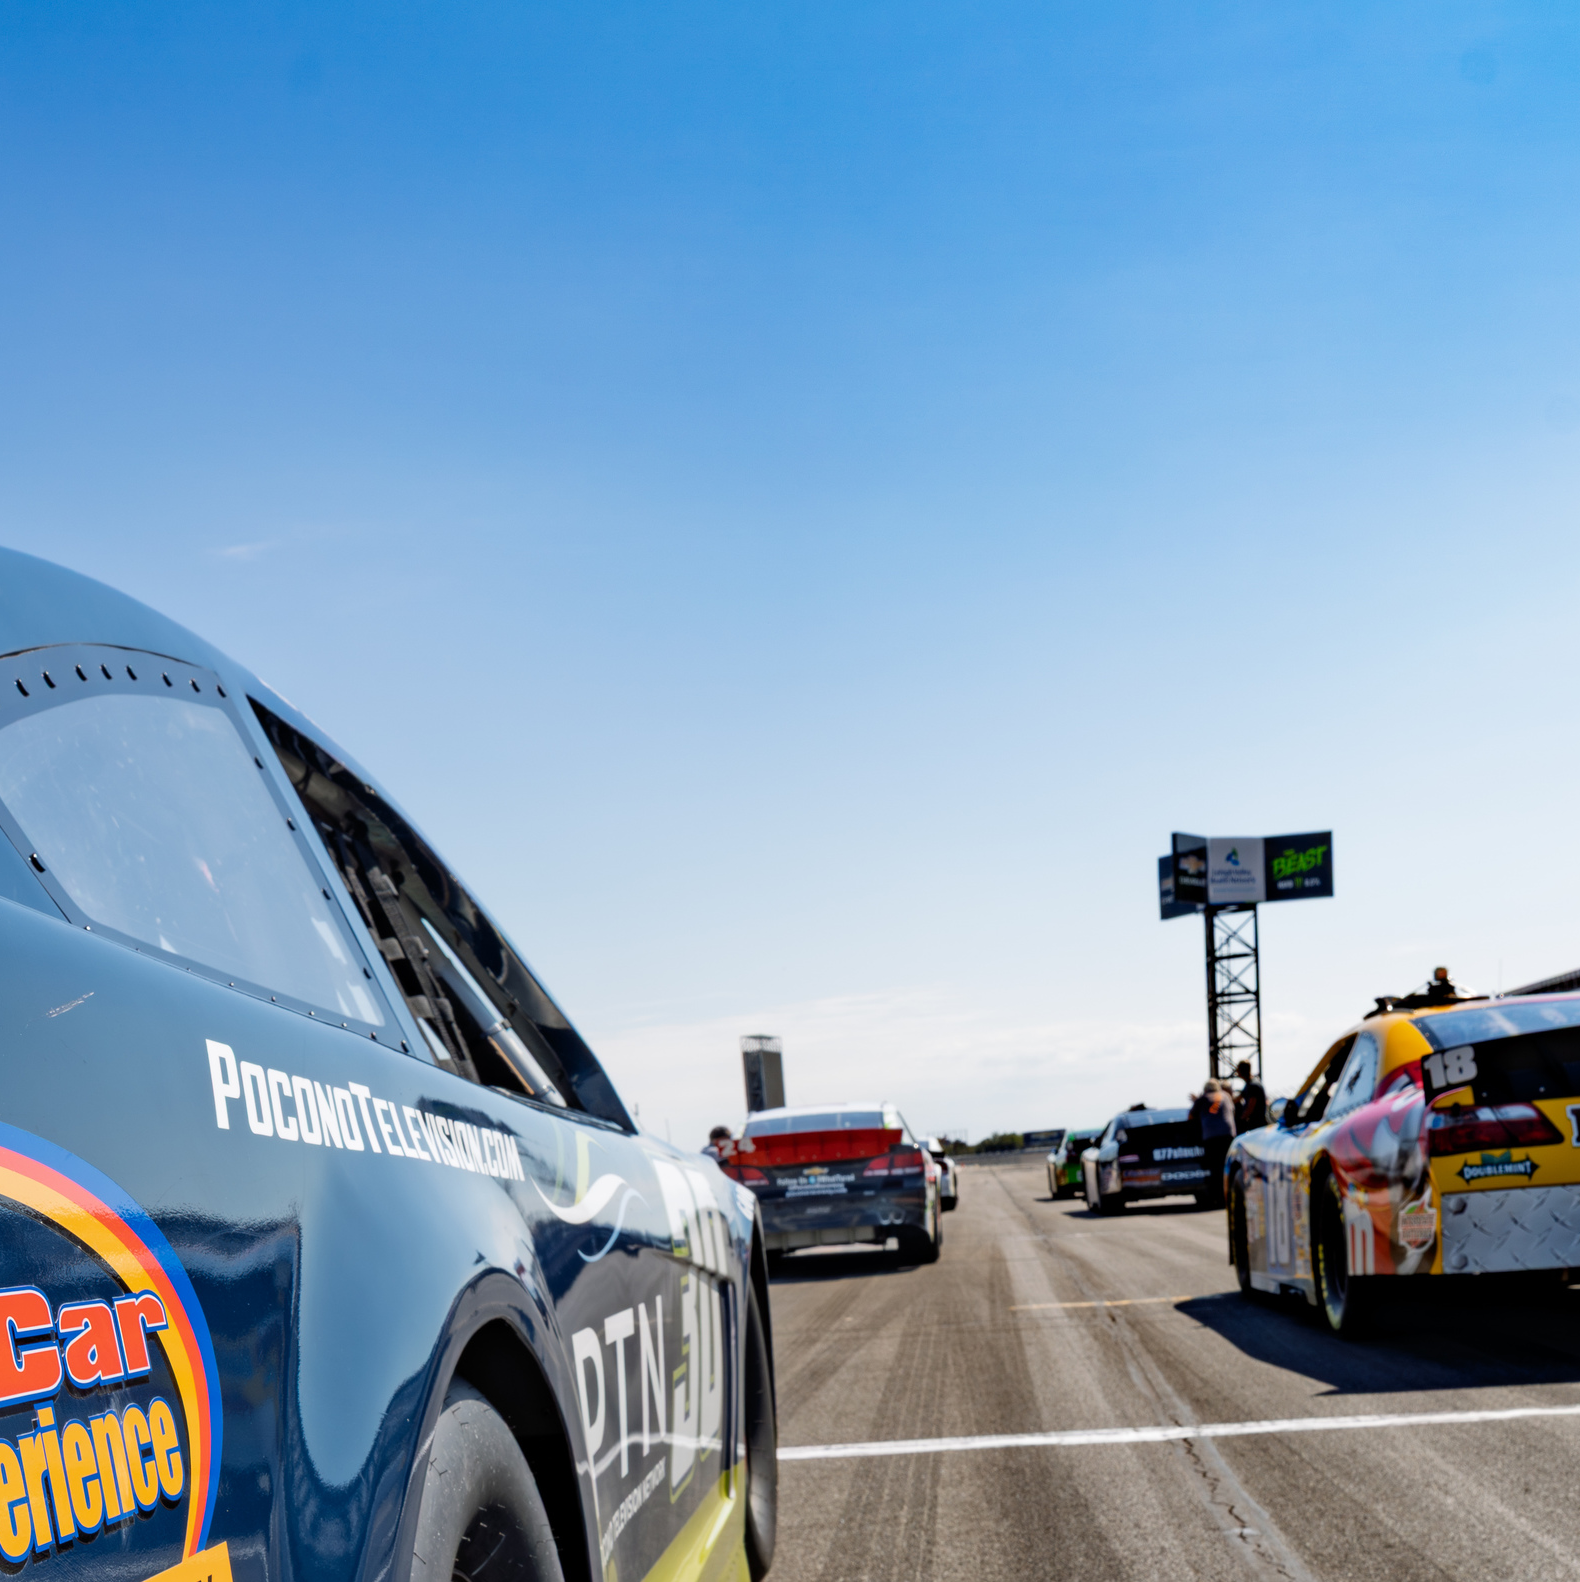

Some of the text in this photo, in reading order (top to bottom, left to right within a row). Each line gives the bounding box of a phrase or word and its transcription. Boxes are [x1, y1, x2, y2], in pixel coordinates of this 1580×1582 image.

[1272, 846, 1327, 880] BEAST
[1424, 1046, 1477, 1089] 18
[719, 1137, 756, 1157] 24
[1463, 1159, 1532, 1180] DOUBLEMINT
[572, 1295, 667, 1479] PTN
